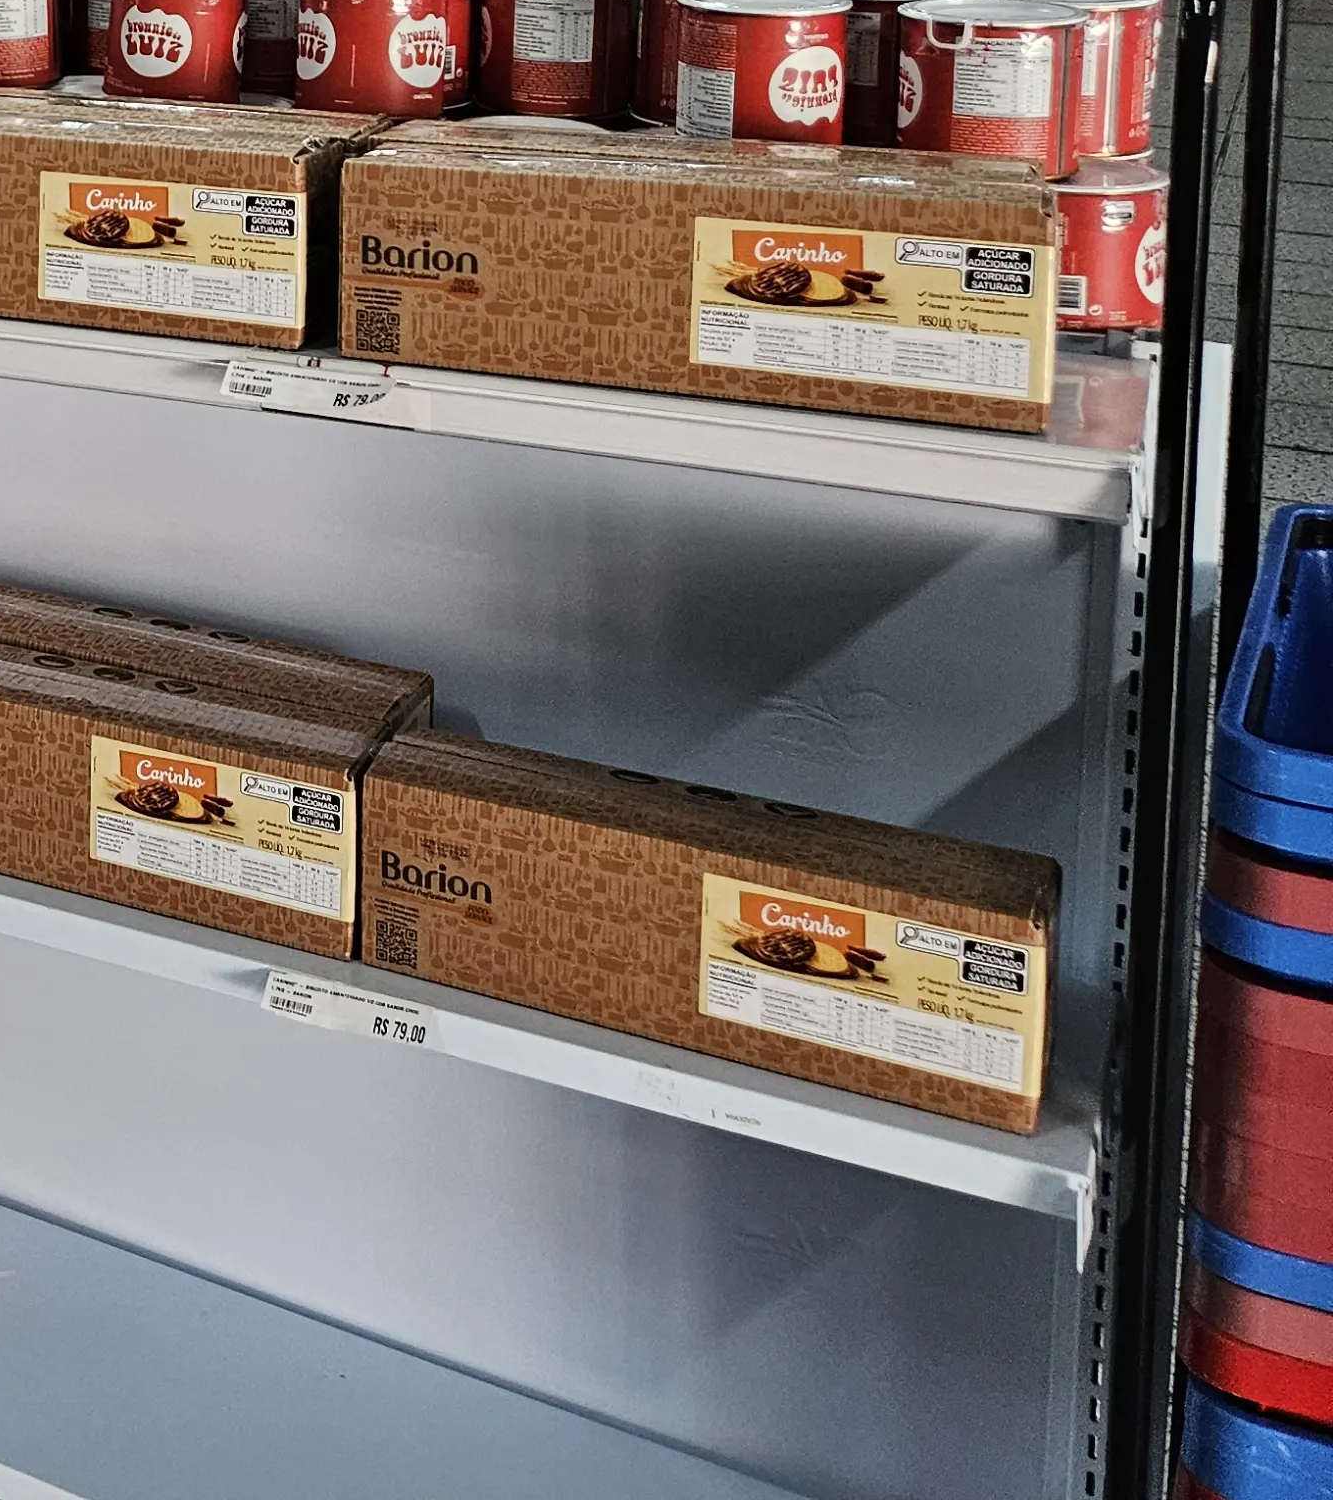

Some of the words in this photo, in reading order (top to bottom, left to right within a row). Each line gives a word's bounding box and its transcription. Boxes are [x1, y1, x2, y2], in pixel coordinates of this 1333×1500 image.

[126, 19, 173, 36] brownie
[125, 33, 183, 62] LUIZ
[86, 189, 157, 211] Carinho
[210, 198, 229, 207] ALTO
[230, 199, 242, 208] EM
[247, 205, 294, 216] ADICIONADO
[250, 224, 290, 235] SATURADA
[251, 217, 289, 227] GORDURA
[361, 235, 478, 274] Barion
[754, 237, 847, 264] Carinho
[919, 249, 943, 259] ALTO
[945, 251, 960, 261] EM
[210, 255, 226, 266] PESO
[248, 258, 256, 271] kg
[968, 257, 1029, 272] ADICIONADO
[972, 270, 1023, 283] GORDURA
[971, 280, 1025, 294] SATURADA
[918, 314, 937, 326] PESO
[968, 320, 978, 334] kg
[333, 393, 349, 407] R$
[136, 759, 206, 789] Carinho
[258, 783, 275, 794] ALTO
[276, 786, 288, 796] EM
[294, 796, 339, 812] ADICIONADO
[296, 814, 336, 830] SATURADA
[298, 807, 334, 822] GORDURA
[381, 850, 492, 904] Barion
[761, 902, 851, 938] Carinho
[919, 933, 941, 946] ALTO
[943, 938, 958, 950] EM
[964, 949, 1023, 970] ADICIONADO
[968, 962, 1018, 982] GORDURA
[967, 972, 1019, 991] SATURADA
[373, 1016, 390, 1036] R$
[393, 1021, 426, 1044] 79,00
